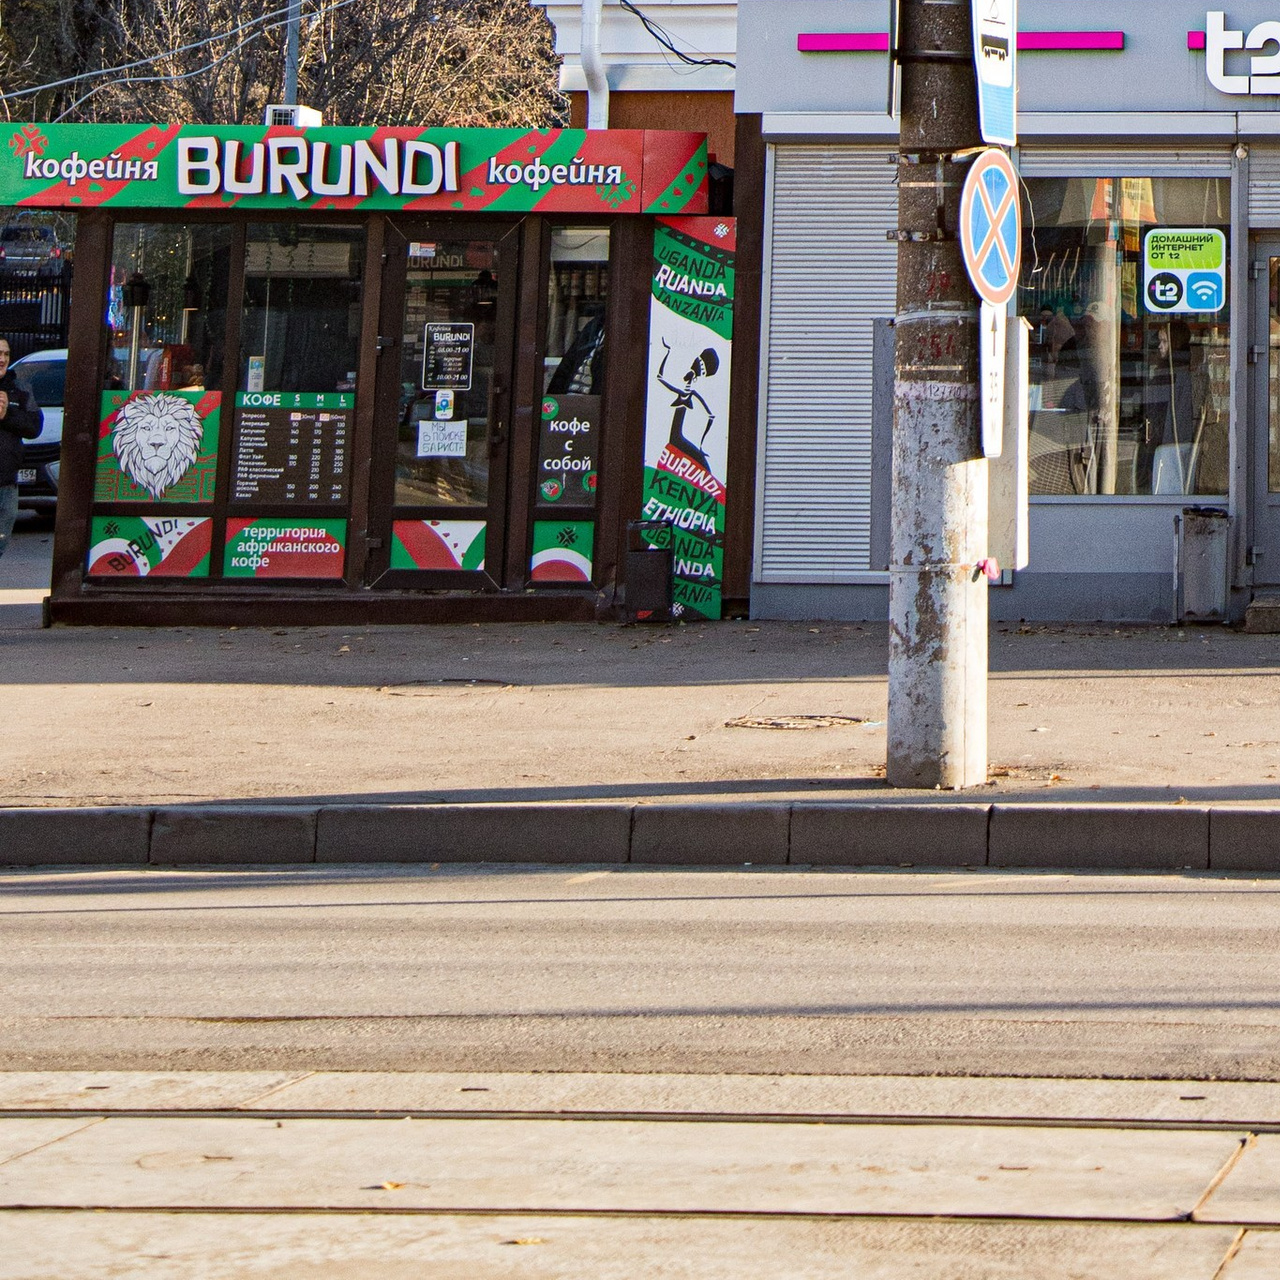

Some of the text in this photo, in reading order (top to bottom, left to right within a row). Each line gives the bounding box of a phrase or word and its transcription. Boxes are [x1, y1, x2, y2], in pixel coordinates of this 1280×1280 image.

[24, 150, 159, 185] кофейня
[178, 136, 460, 200] BURUNDI
[487, 156, 622, 191] кофейня
[1151, 234, 1213, 243] ДОМАШНИЙ
[659, 246, 726, 279] UGANDA
[655, 264, 726, 296] RUANDA
[1156, 280, 1177, 301] t2
[658, 290, 724, 322] TANZANIA
[434, 333, 470, 341] BURUNDI
[243, 394, 281, 405] КОФЕ
[432, 422, 446, 431] МЫ
[550, 417, 590, 434] кофе
[433, 431, 465, 441] ПОИСКЕ
[422, 442, 464, 453] БАРИСТА
[565, 440, 573, 451] с
[544, 456, 591, 471] собой
[659, 448, 721, 497] BURUNDI
[649, 469, 718, 516] KENYA
[643, 497, 716, 534] ETHIOPIA
[244, 527, 326, 541] территория
[107, 519, 178, 572] BURUNDI
[237, 540, 340, 556] африканского
[231, 553, 269, 570] кофе
